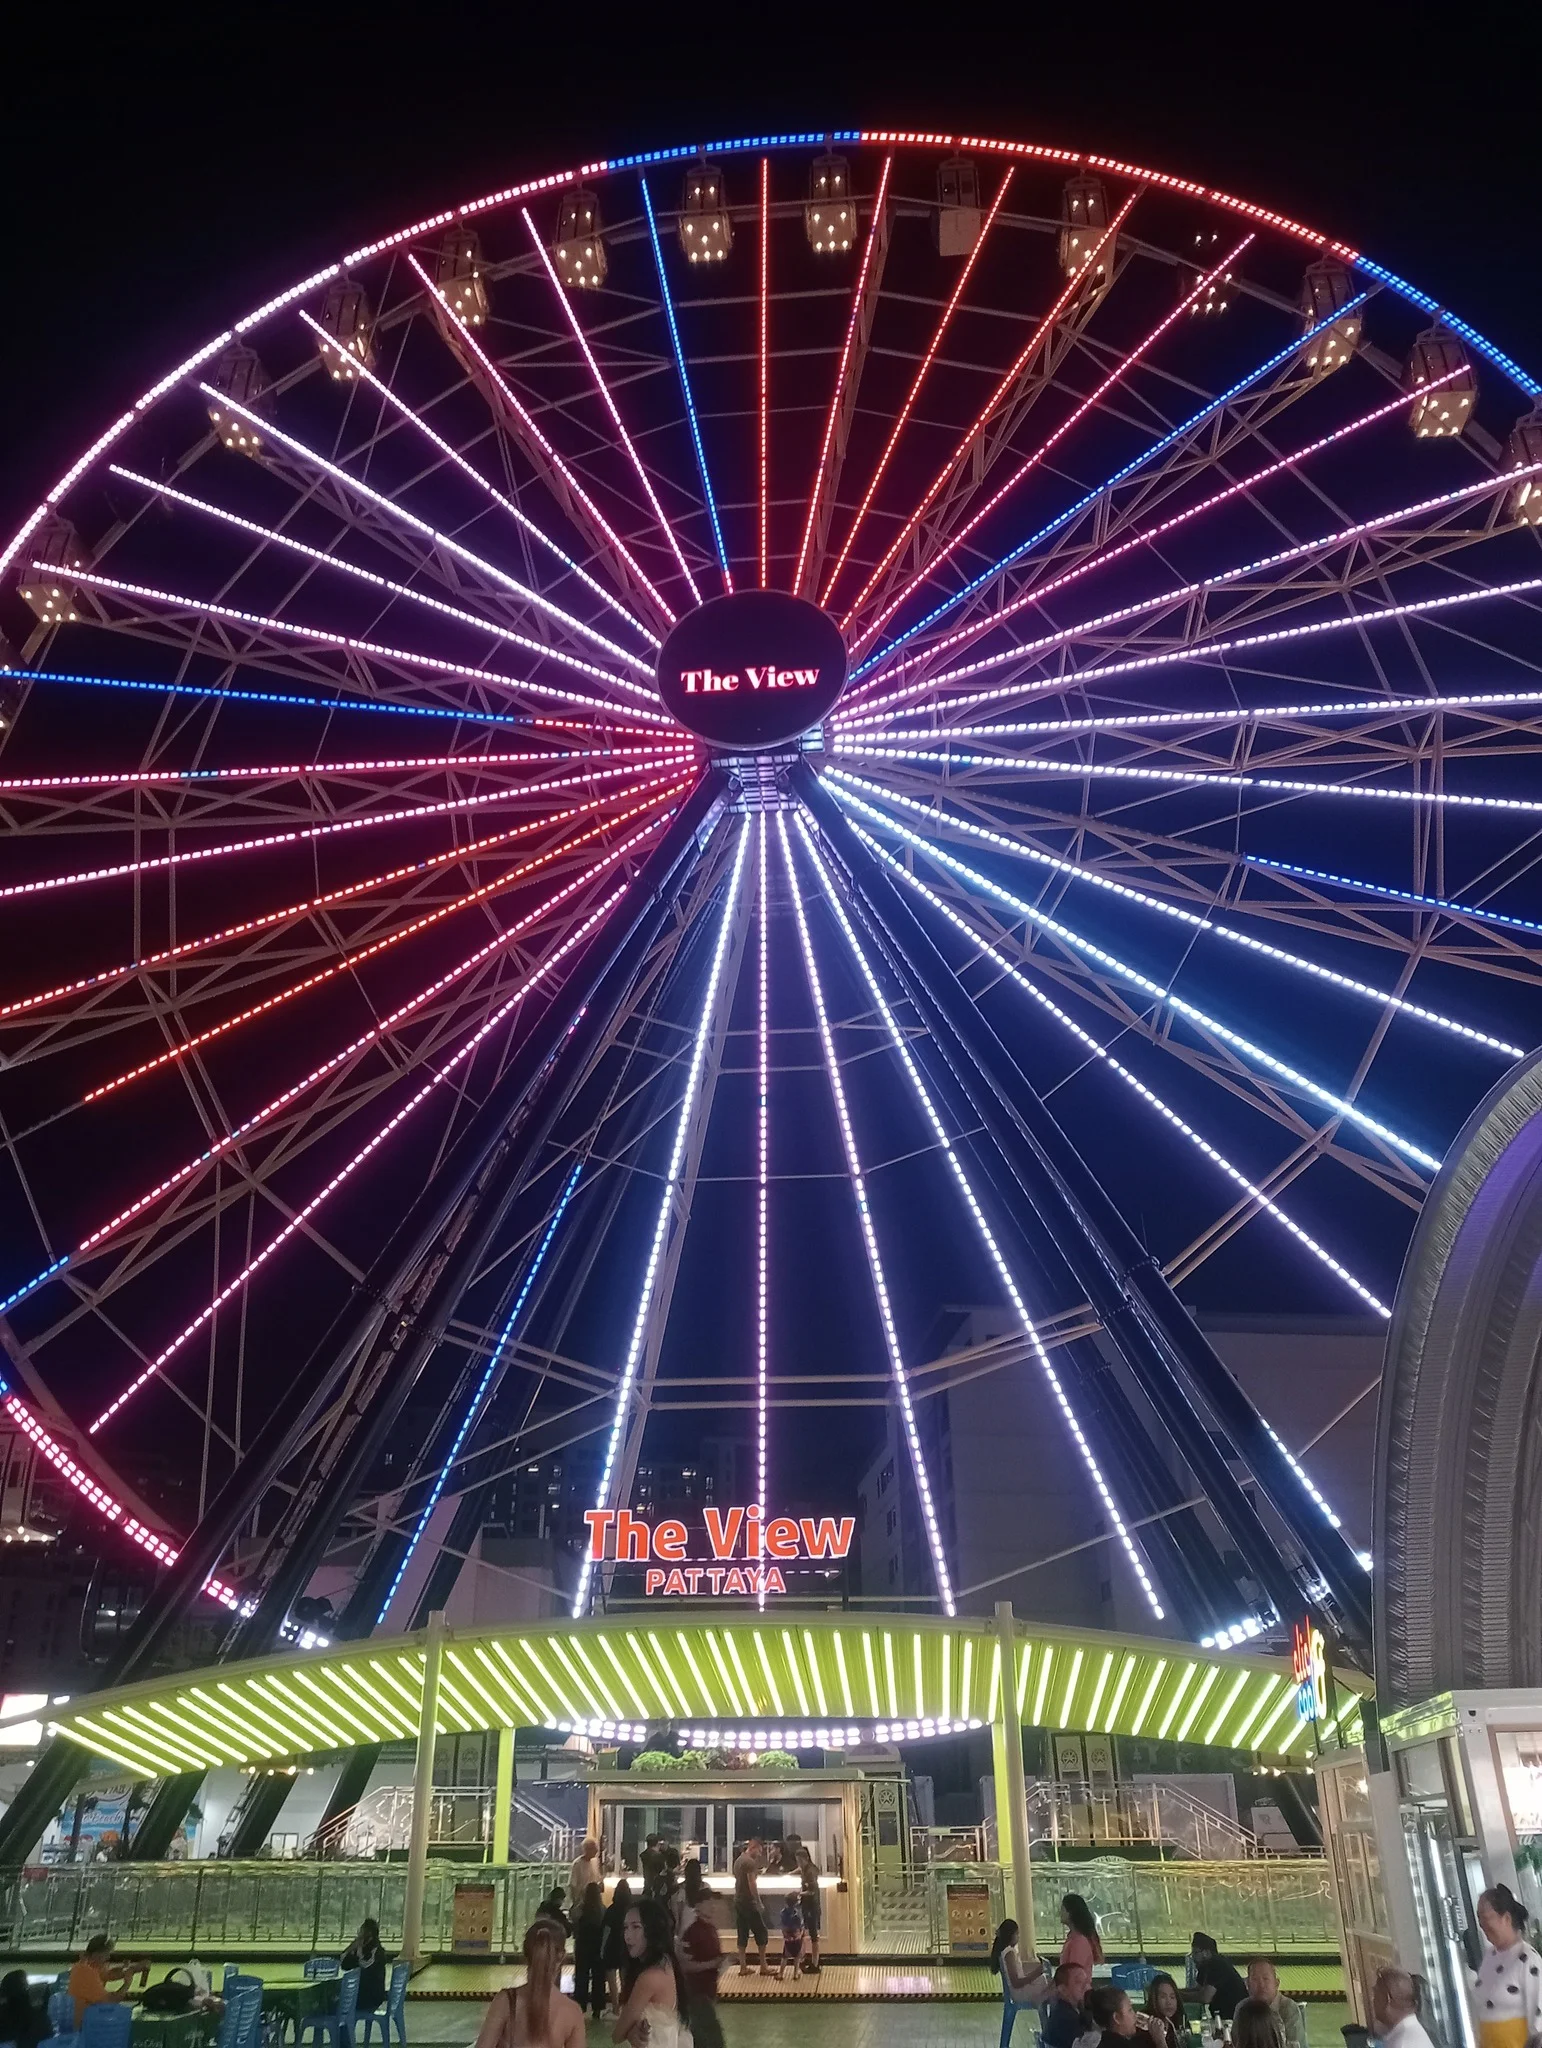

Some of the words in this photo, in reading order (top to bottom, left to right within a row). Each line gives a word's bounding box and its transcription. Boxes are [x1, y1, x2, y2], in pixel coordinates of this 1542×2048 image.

[680, 668, 739, 693] The
[744, 665, 820, 690] View
[583, 1509, 688, 1561] The
[702, 1503, 856, 1560] View
[645, 1566, 787, 1596] PATTAYA
